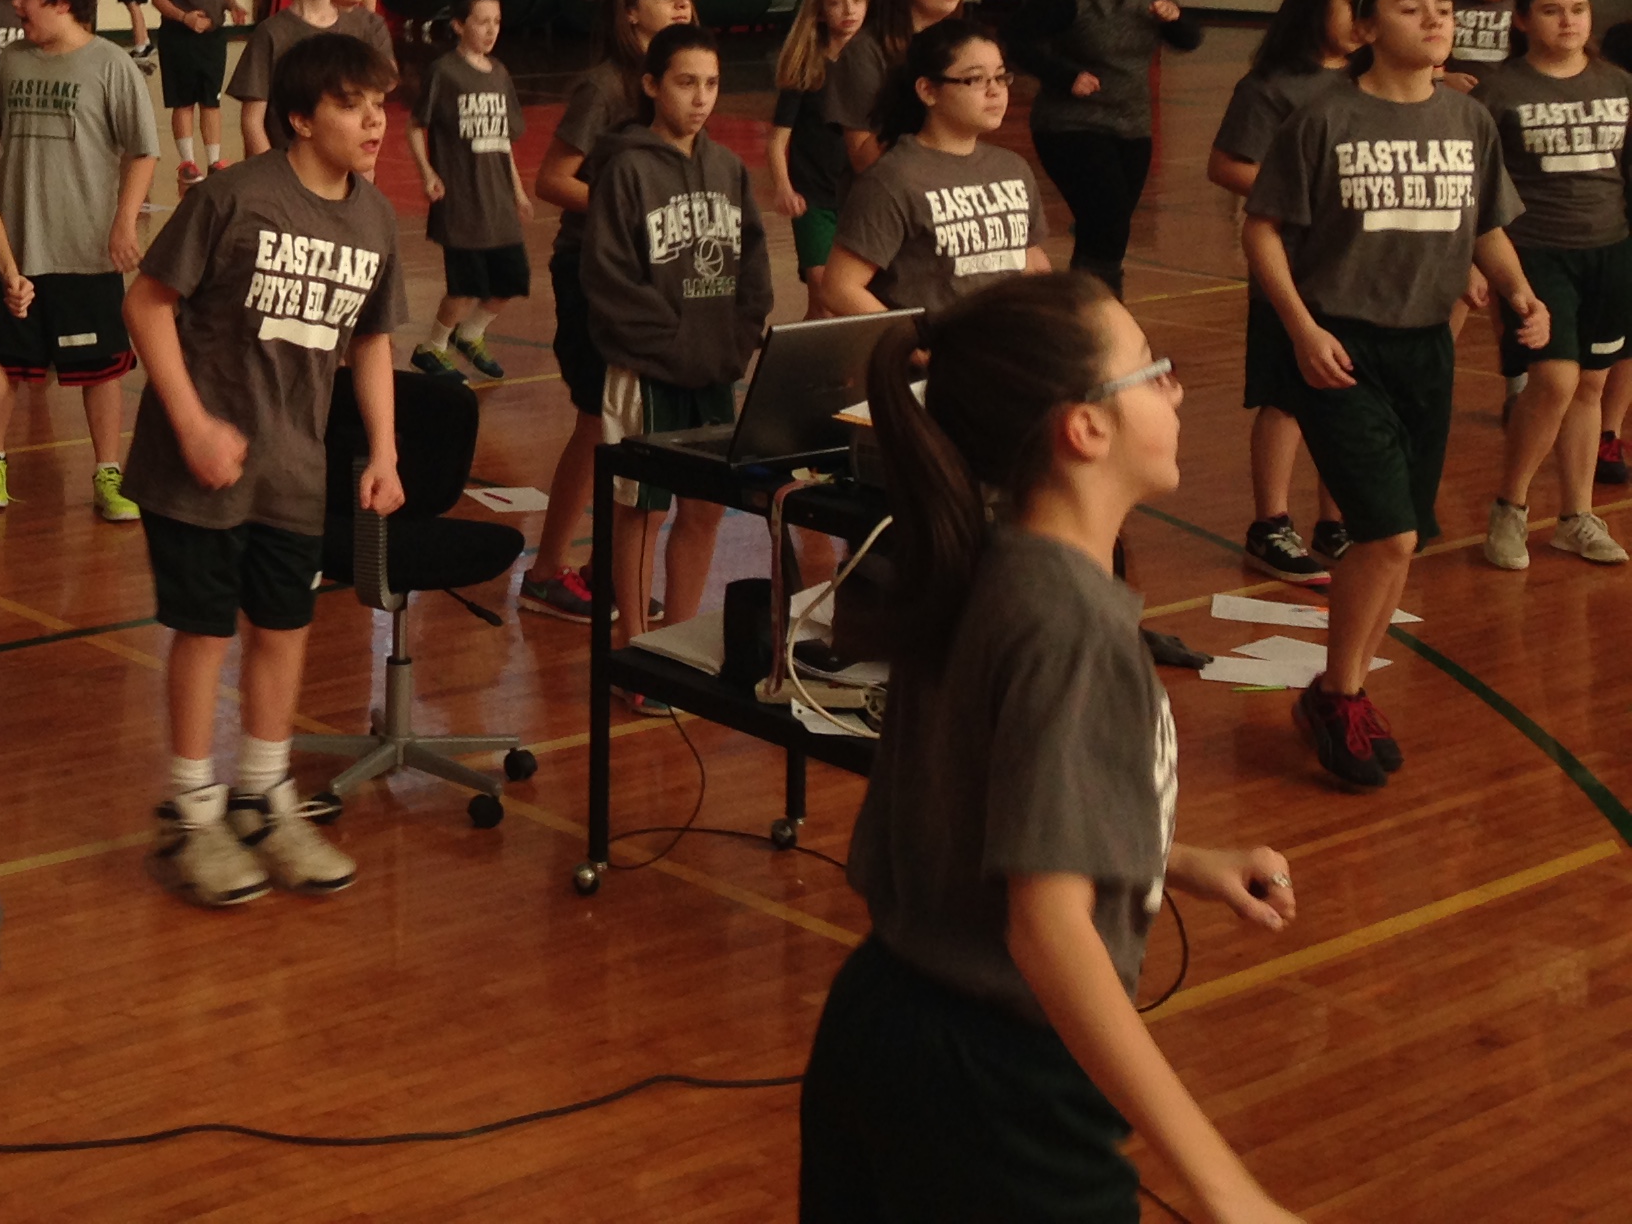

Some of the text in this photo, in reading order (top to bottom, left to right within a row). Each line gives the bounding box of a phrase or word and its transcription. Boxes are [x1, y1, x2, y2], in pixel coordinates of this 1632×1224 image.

[1454, 9, 1513, 29] ASTLA
[8, 78, 81, 99] EASTLAKE
[1516, 96, 1630, 128] EASTLAKE
[1334, 139, 1475, 176] EASTLAKE
[1571, 126, 1596, 153] ED.
[924, 178, 1030, 224] EASTLAKE
[1339, 174, 1476, 210] PHYS. ED. DEPT.
[934, 219, 985, 258] PHYS.
[984, 217, 1009, 249] ED.
[254, 229, 380, 290] EASTLAKE
[243, 270, 303, 317] PHYS.
